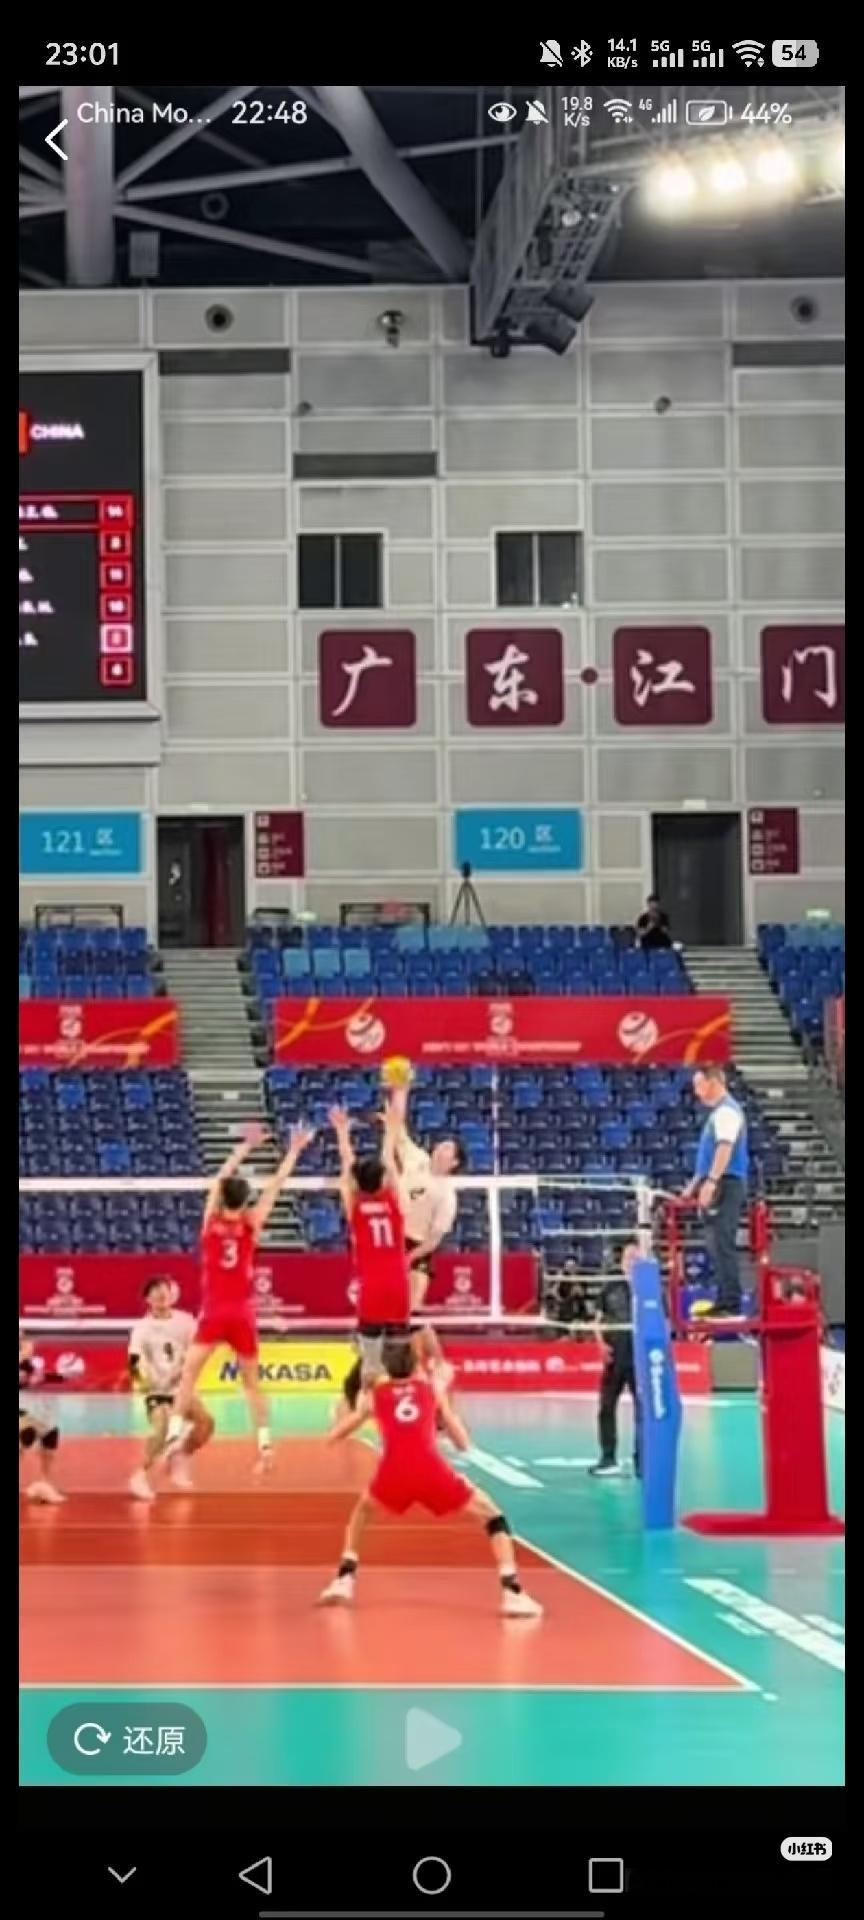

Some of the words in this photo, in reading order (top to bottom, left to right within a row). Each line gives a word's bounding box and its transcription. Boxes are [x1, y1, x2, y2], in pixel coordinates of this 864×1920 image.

[30, 423, 84, 440] CHINA
[41, 830, 85, 854] 121
[480, 825, 526, 850] 120
[368, 1216, 395, 1249] 11
[220, 1239, 239, 1270] 3
[219, 1361, 332, 1382] MKASA
[394, 1396, 419, 1423] 6
